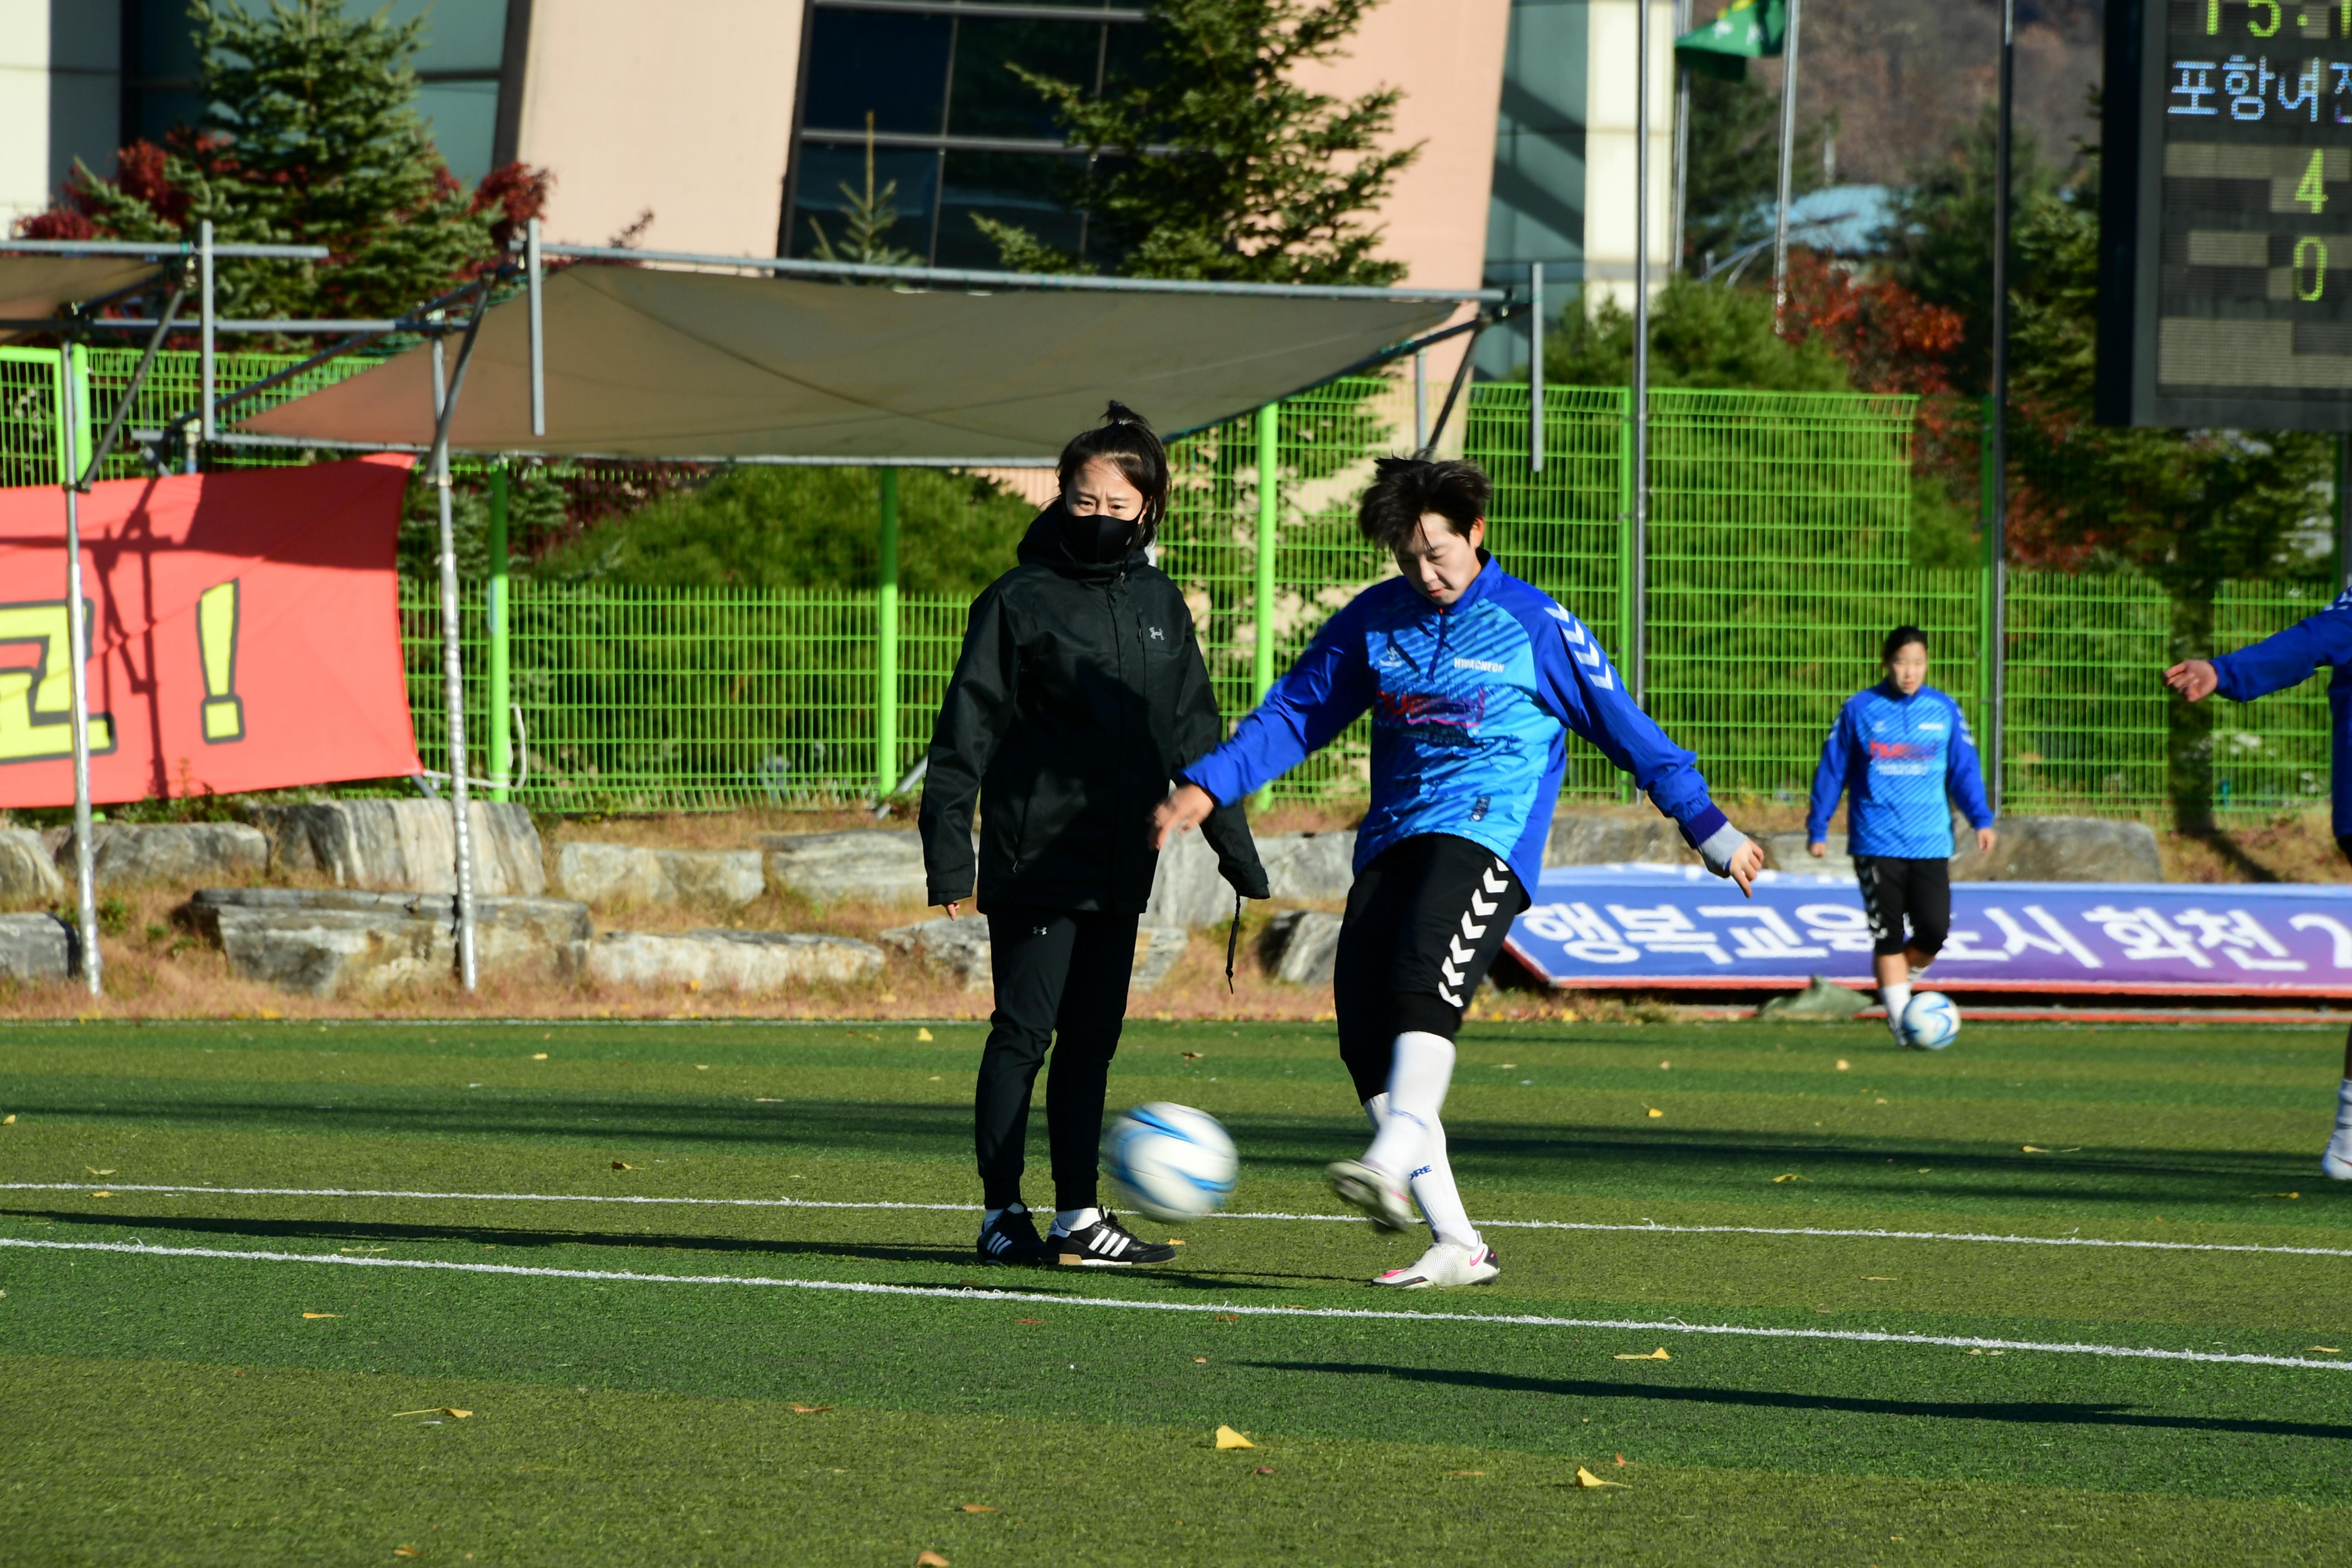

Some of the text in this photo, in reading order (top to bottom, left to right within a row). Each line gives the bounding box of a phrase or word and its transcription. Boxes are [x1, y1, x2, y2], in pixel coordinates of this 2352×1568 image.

[2295, 149, 2328, 213] 4
[2293, 236, 2327, 301] 0
[2081, 905, 2307, 971] 화천
